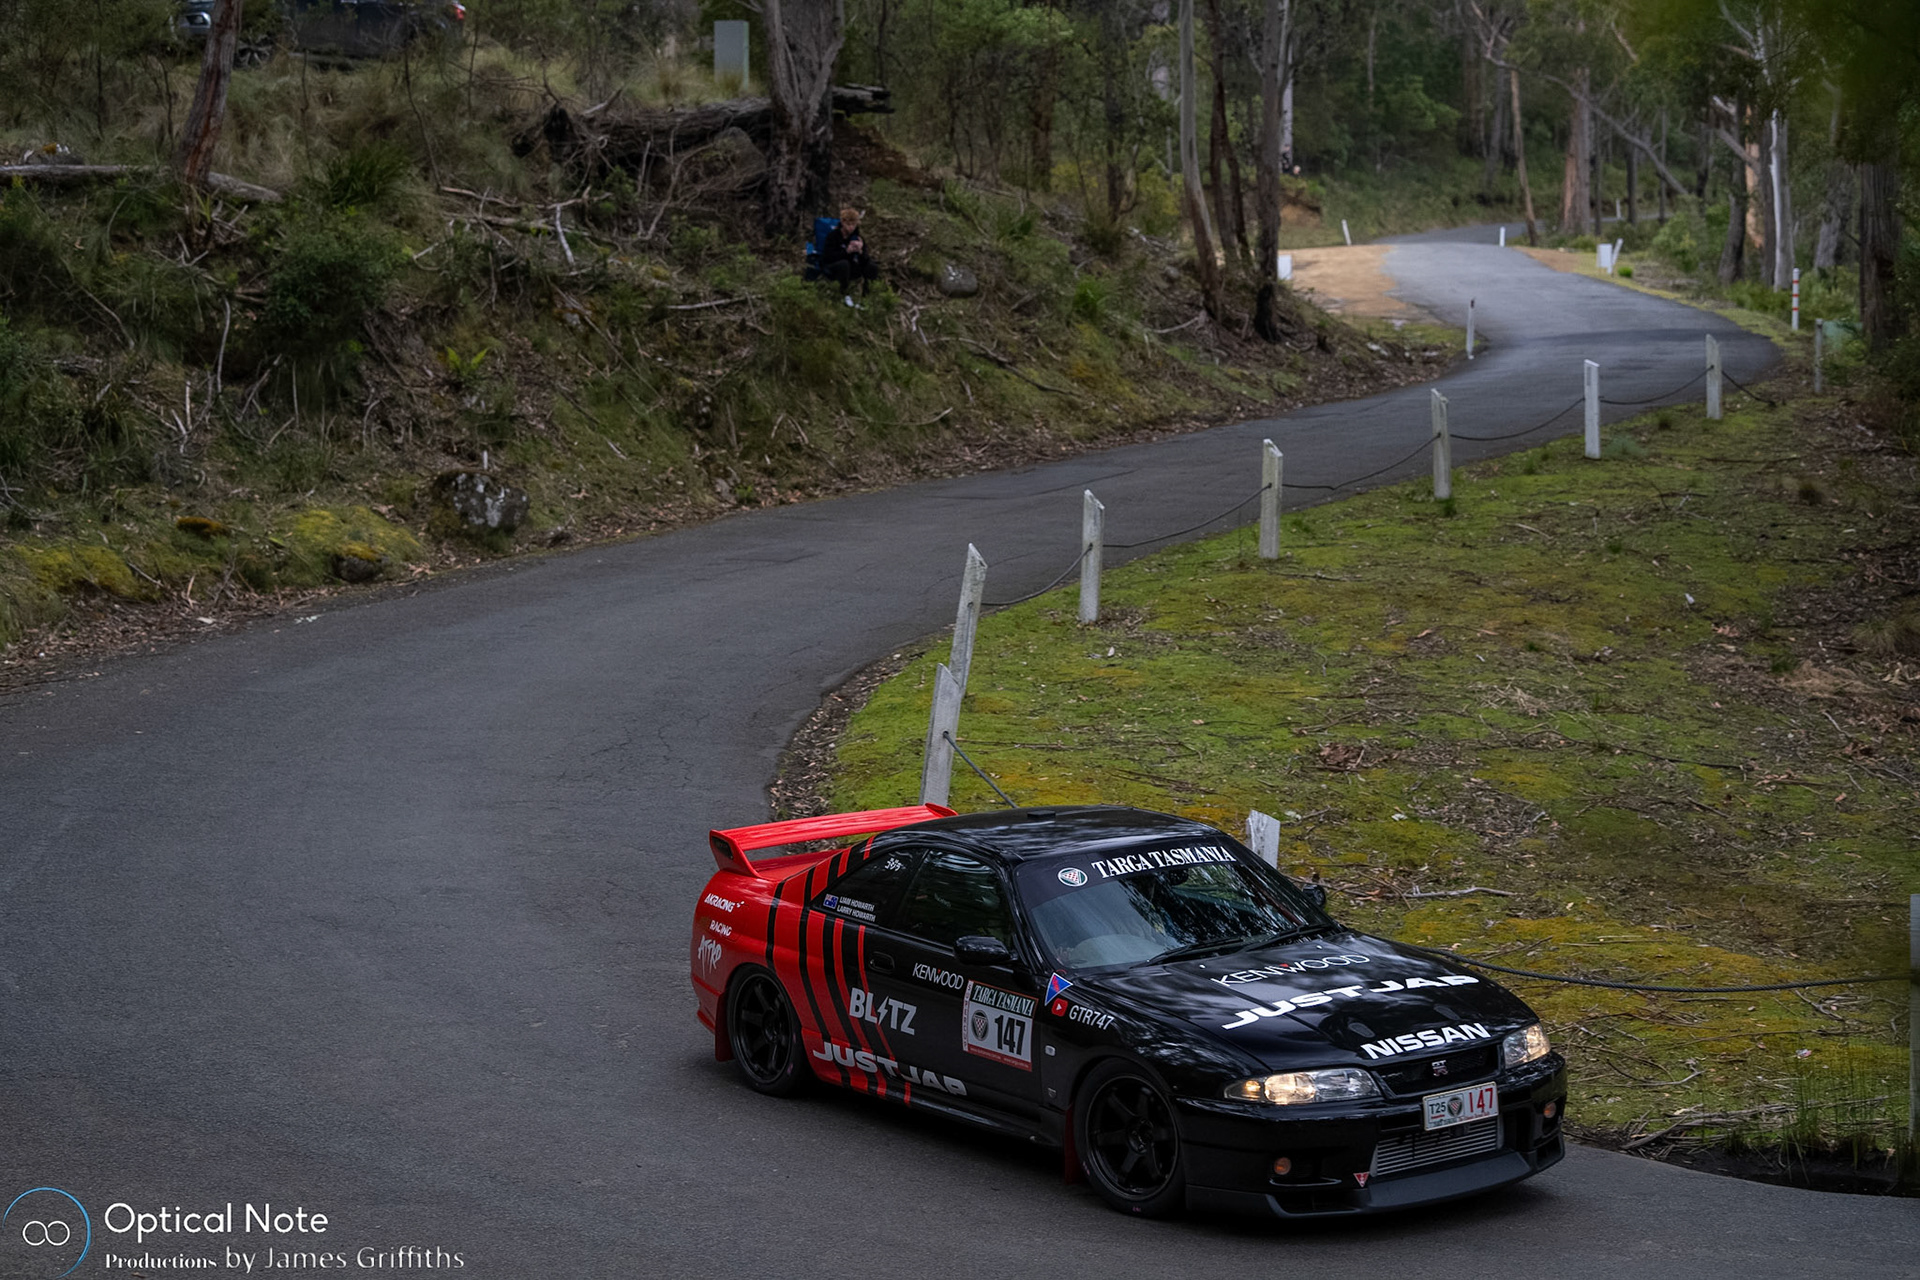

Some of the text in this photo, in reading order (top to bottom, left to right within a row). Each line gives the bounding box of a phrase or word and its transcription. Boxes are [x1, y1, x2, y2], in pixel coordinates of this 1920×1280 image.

[1091, 846, 1237, 879] TARGA TASMANIA
[709, 920, 732, 936] RACING
[912, 963, 964, 990] KENWOOD
[1211, 955, 1370, 987] KENWOOD
[971, 985, 995, 1006] TARGA
[1069, 1005, 1115, 1030] GTR747
[995, 1015, 1026, 1056] 147
[1361, 1023, 1491, 1060] NISSAN
[1429, 1087, 1494, 1114] T25 147
